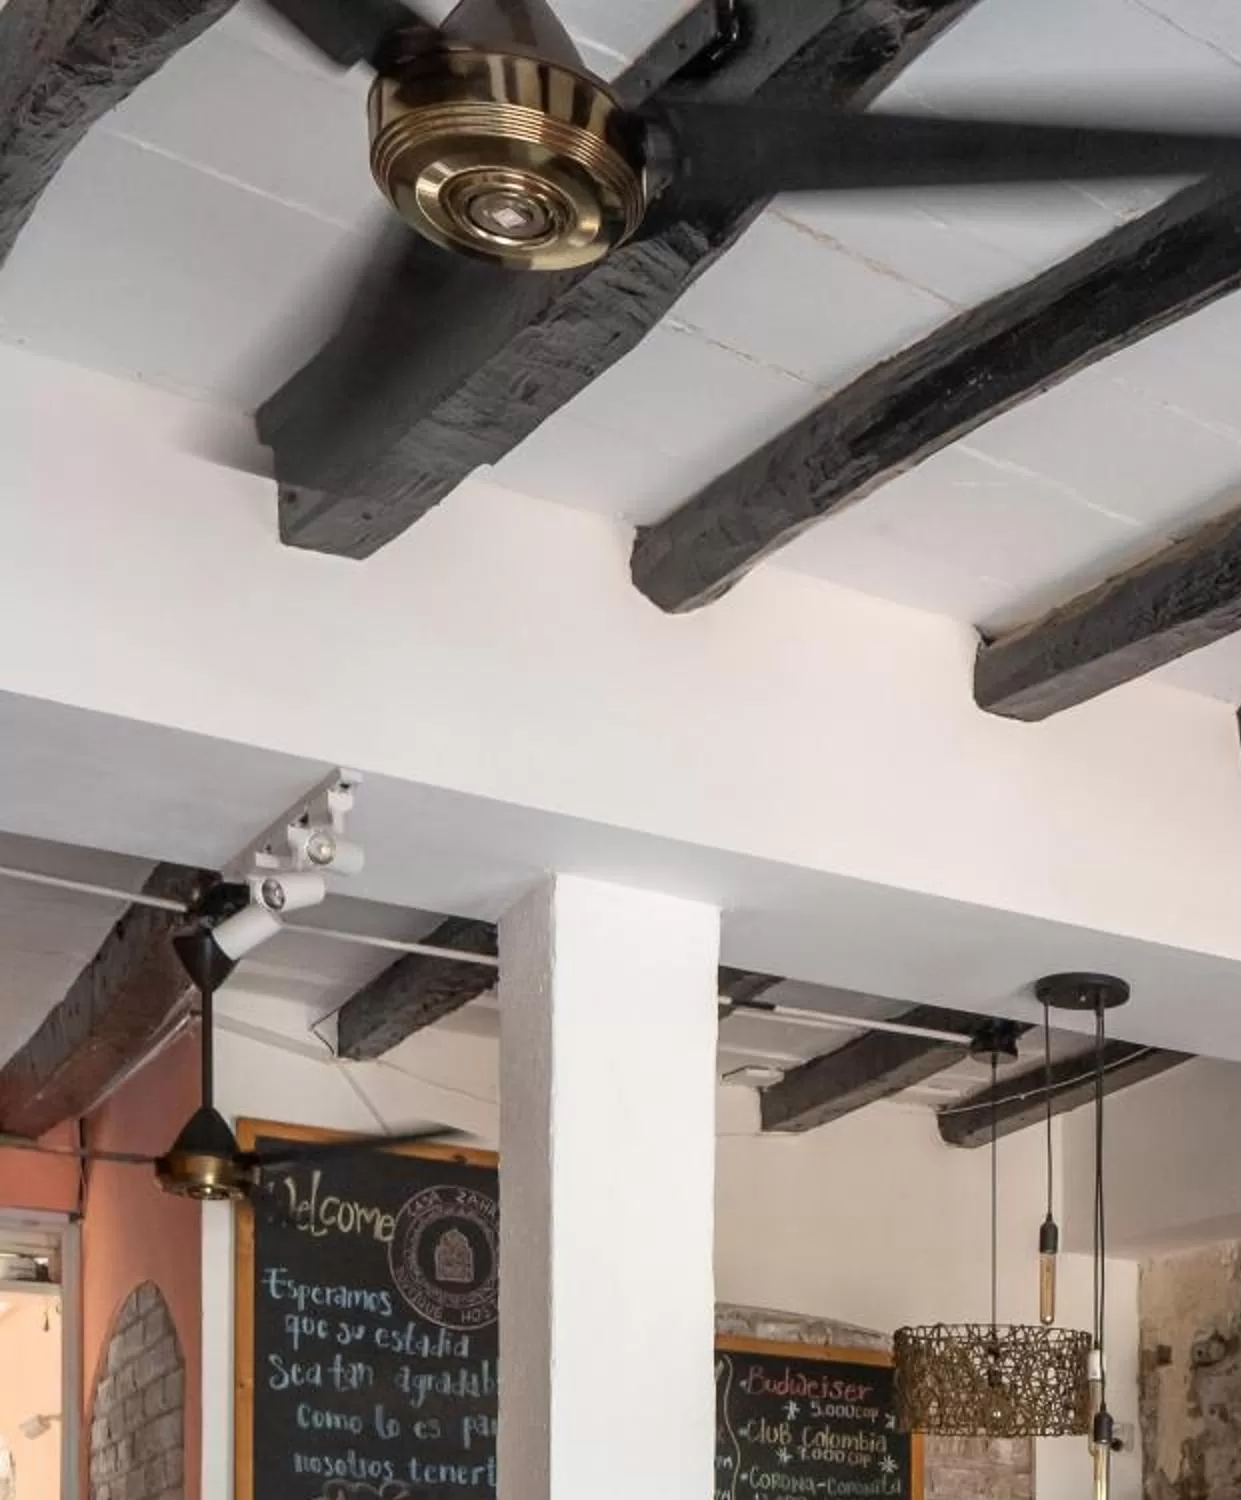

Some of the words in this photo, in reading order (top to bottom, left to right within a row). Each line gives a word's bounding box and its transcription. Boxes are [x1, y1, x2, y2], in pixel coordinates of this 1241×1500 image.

[261, 1266, 393, 1317] Esperamos
[284, 1313, 330, 1351] que
[335, 1322, 366, 1345] su
[268, 1353, 322, 1391] Sea
[327, 1353, 375, 1392] tan
[395, 1359, 499, 1408] agradab
[374, 1403, 401, 1440] lo
[413, 1418, 441, 1440] es
[801, 1423, 888, 1453] Colombia
[293, 1449, 394, 1482] nosotros
